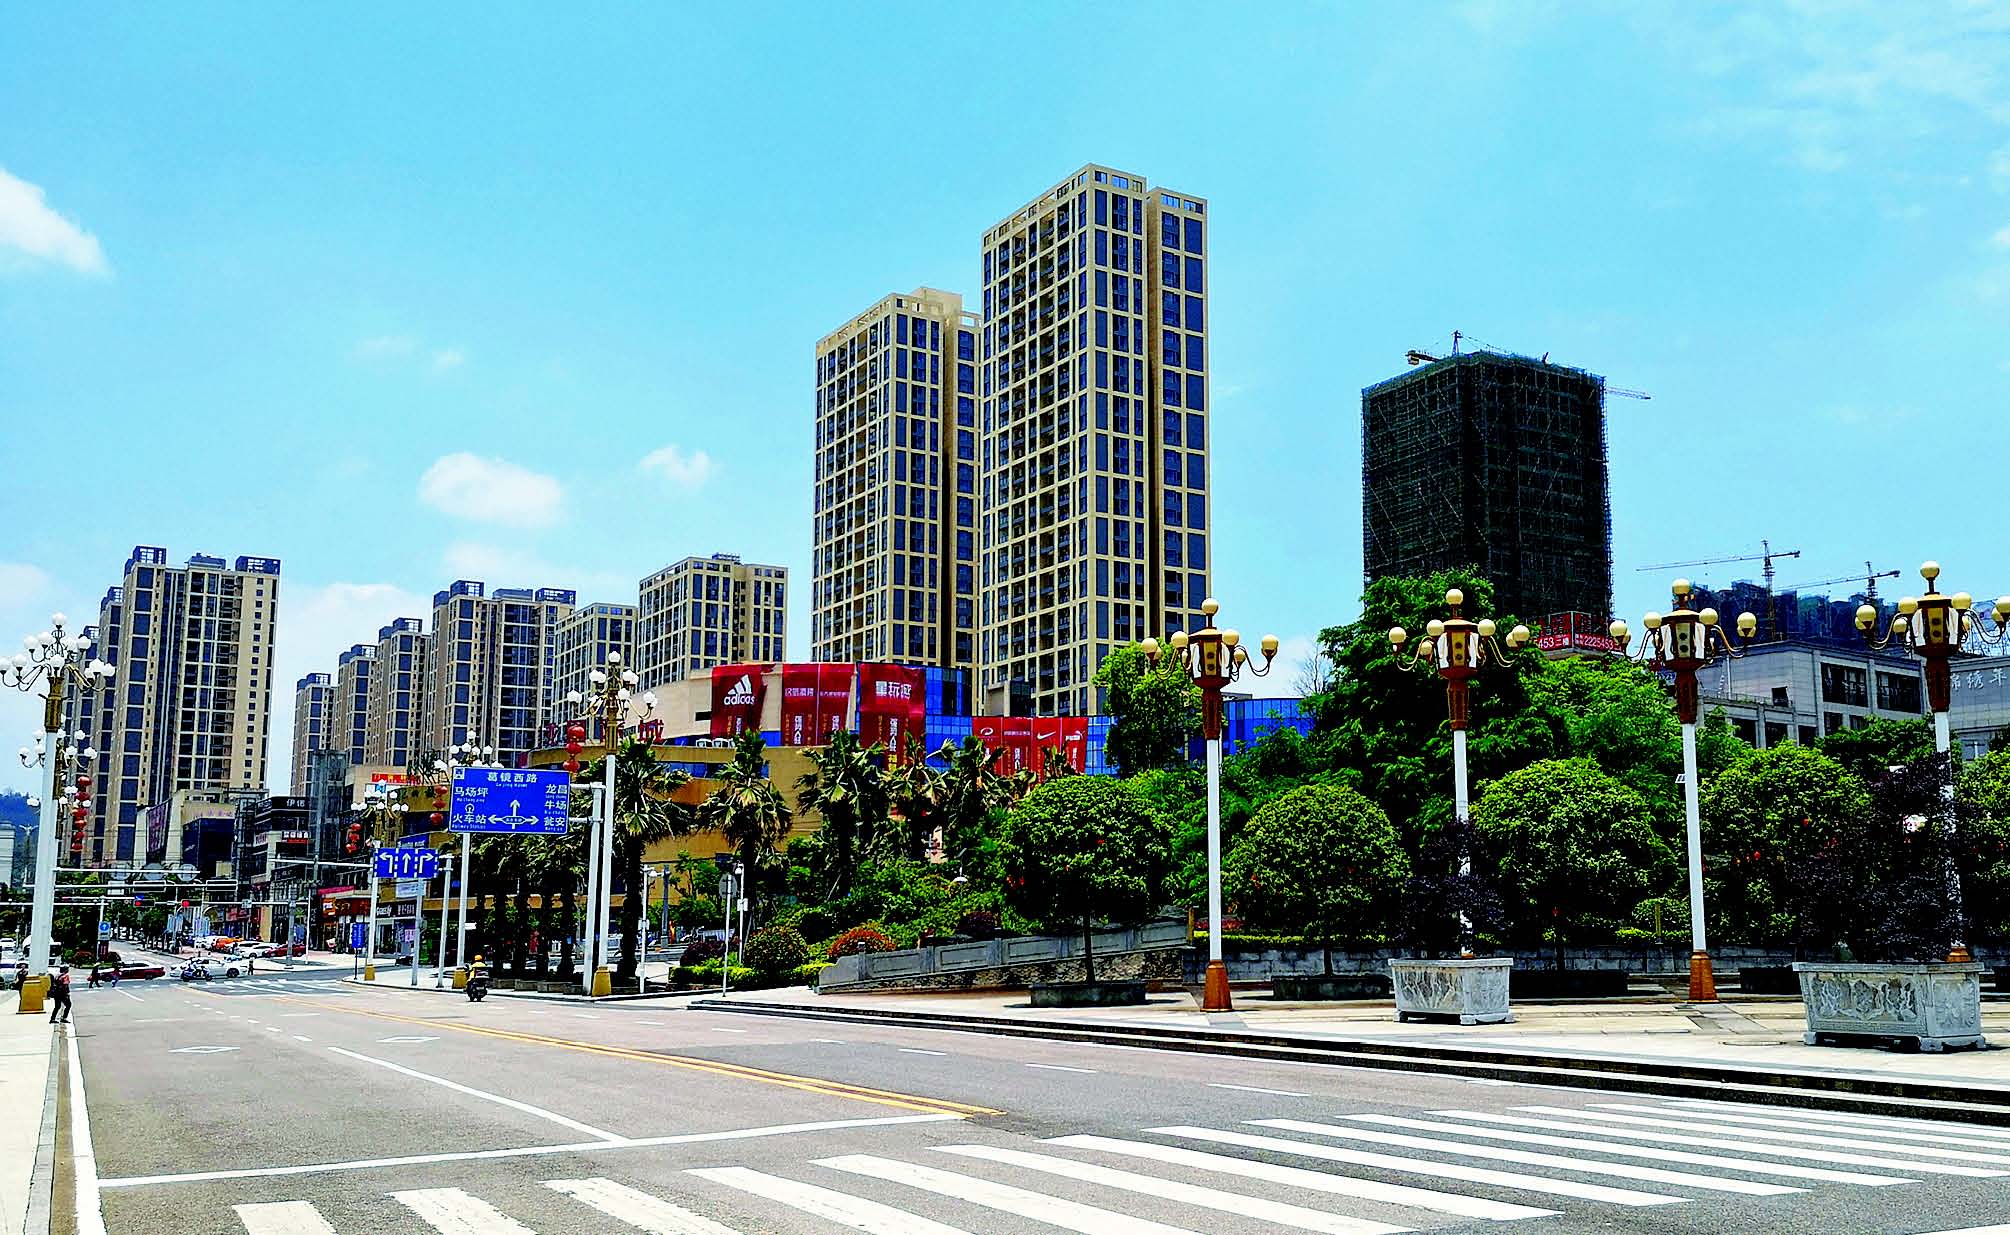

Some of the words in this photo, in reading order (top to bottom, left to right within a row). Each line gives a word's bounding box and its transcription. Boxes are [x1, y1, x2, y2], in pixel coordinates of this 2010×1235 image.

[723, 694, 755, 705] adidas
[487, 772, 538, 783] 葛镜西路
[454, 787, 489, 798] 马场坪
[545, 784, 568, 795] 龙昌
[544, 800, 567, 810] 牛场
[453, 813, 487, 824] 火车站
[544, 816, 565, 827] 瓮安
